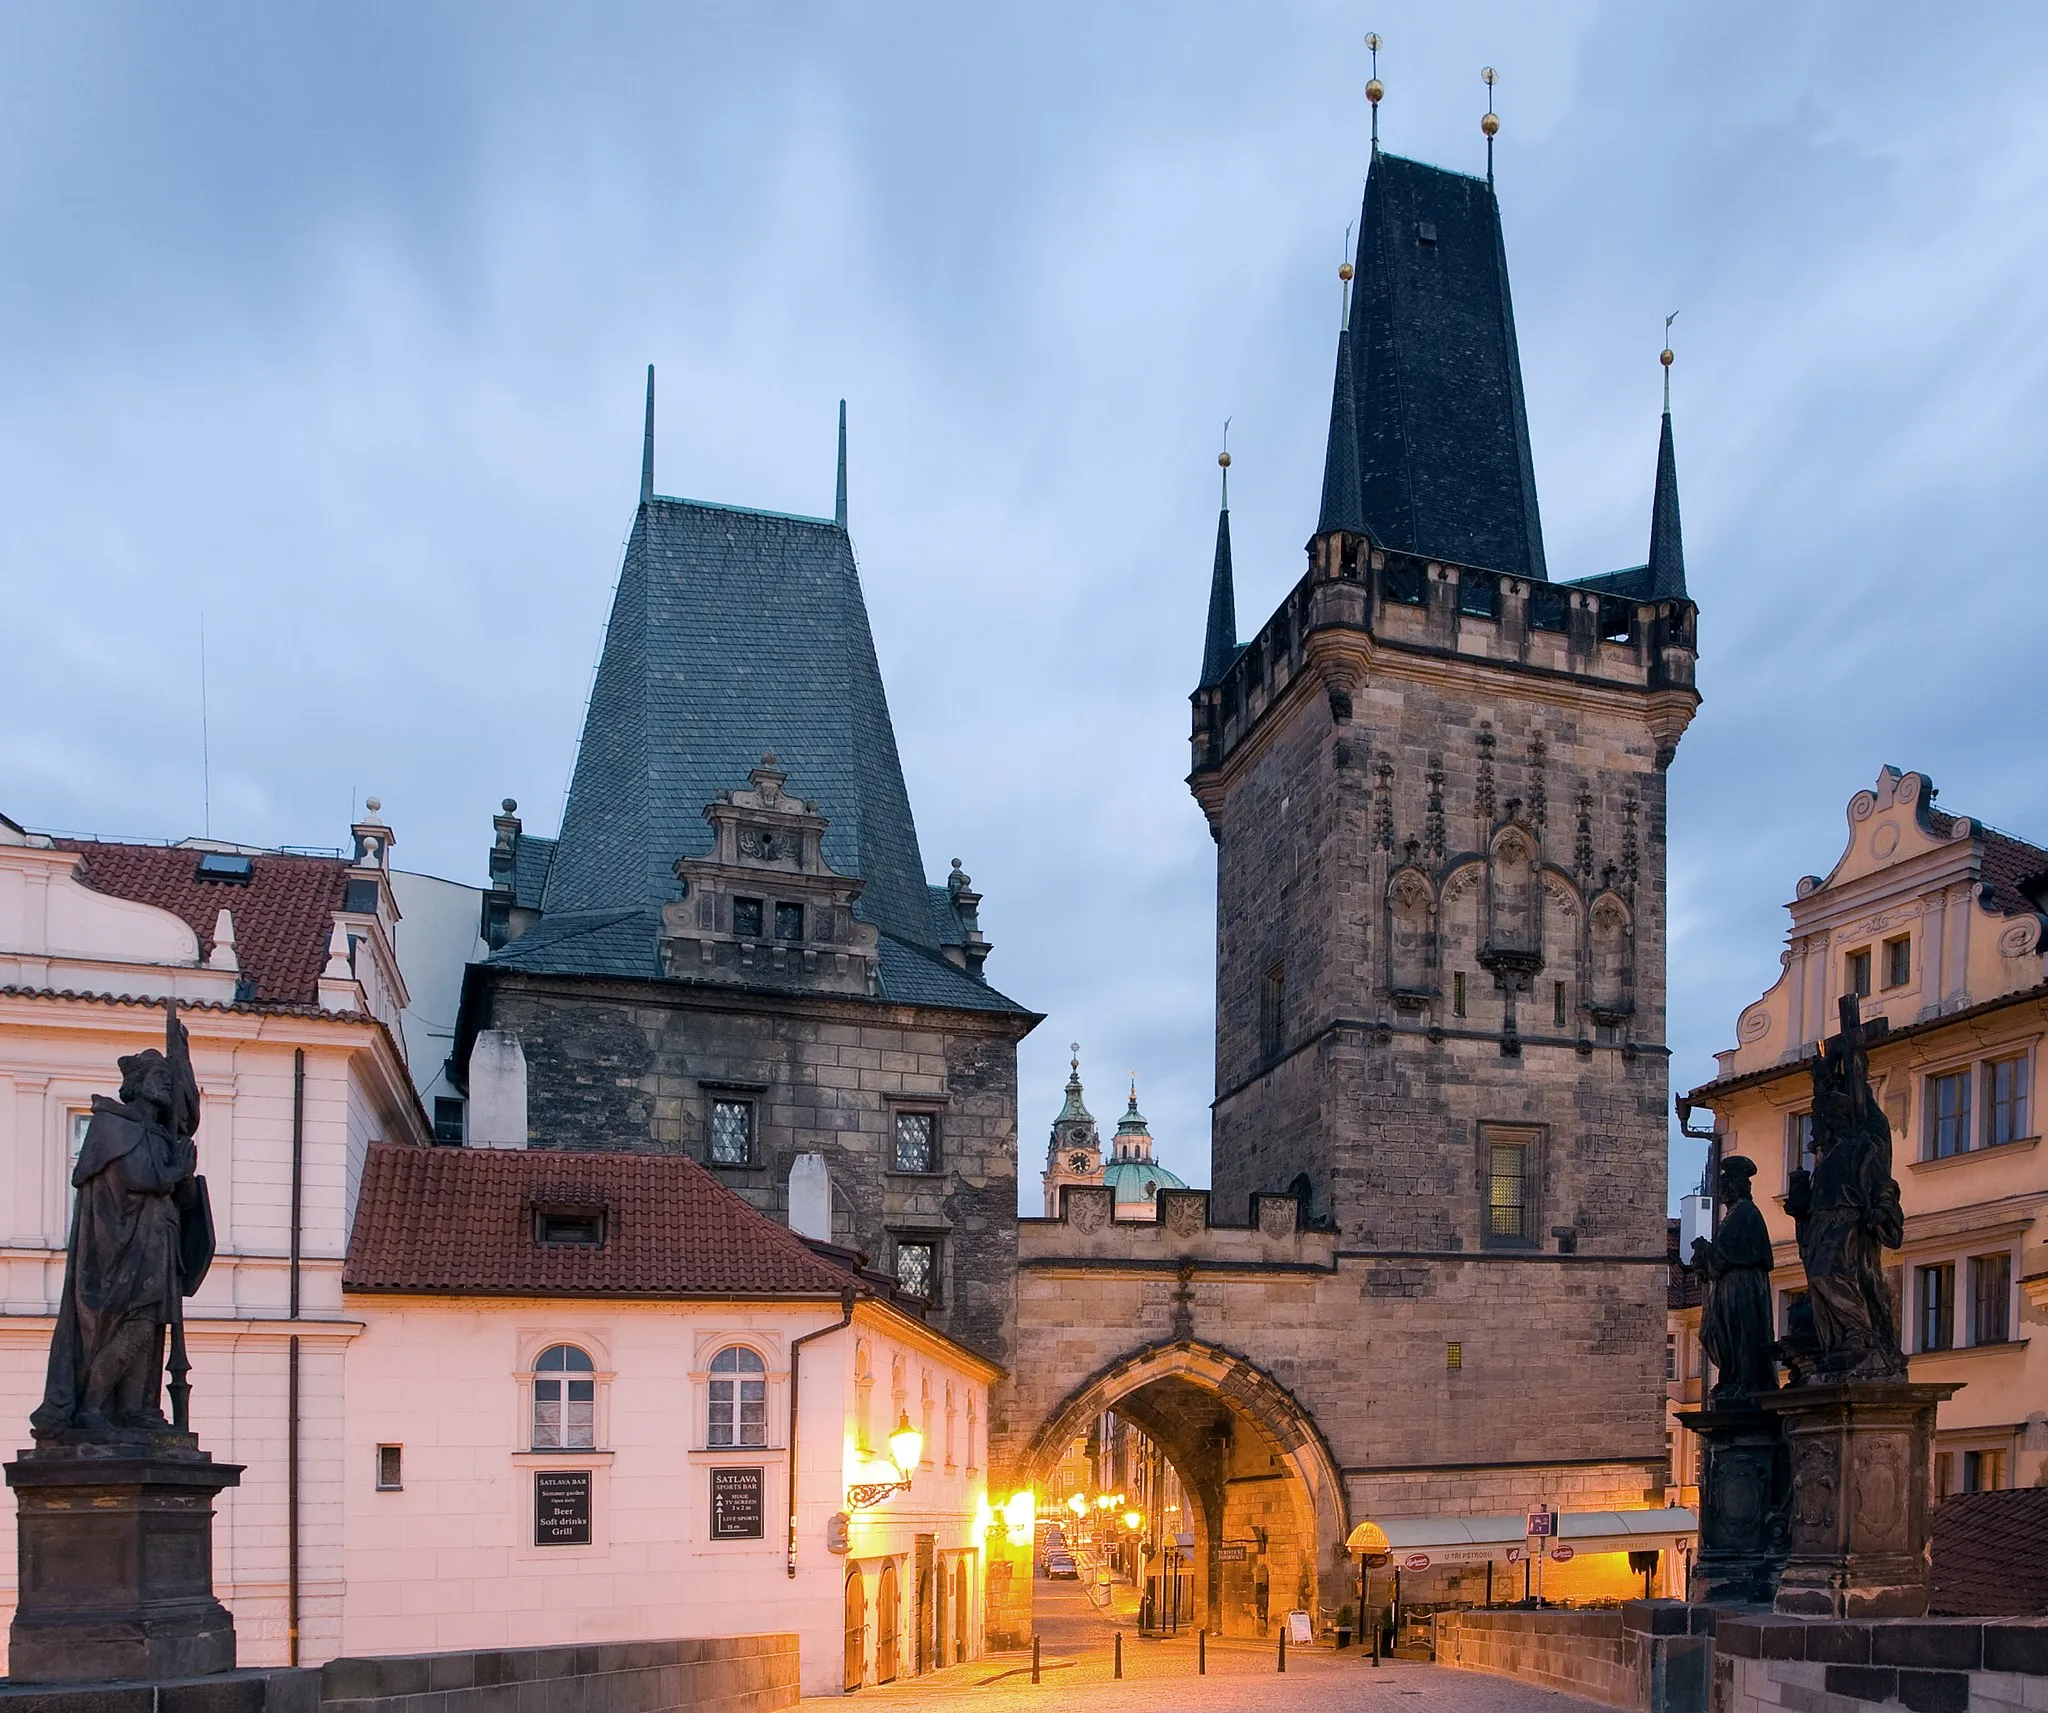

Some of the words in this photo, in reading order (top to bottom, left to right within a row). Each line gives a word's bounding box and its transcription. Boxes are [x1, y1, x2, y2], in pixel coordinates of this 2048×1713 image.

[716, 1475, 757, 1484] ŠATLAVA
[540, 1518, 558, 1526] Soft
[552, 1528, 573, 1536] Grill
